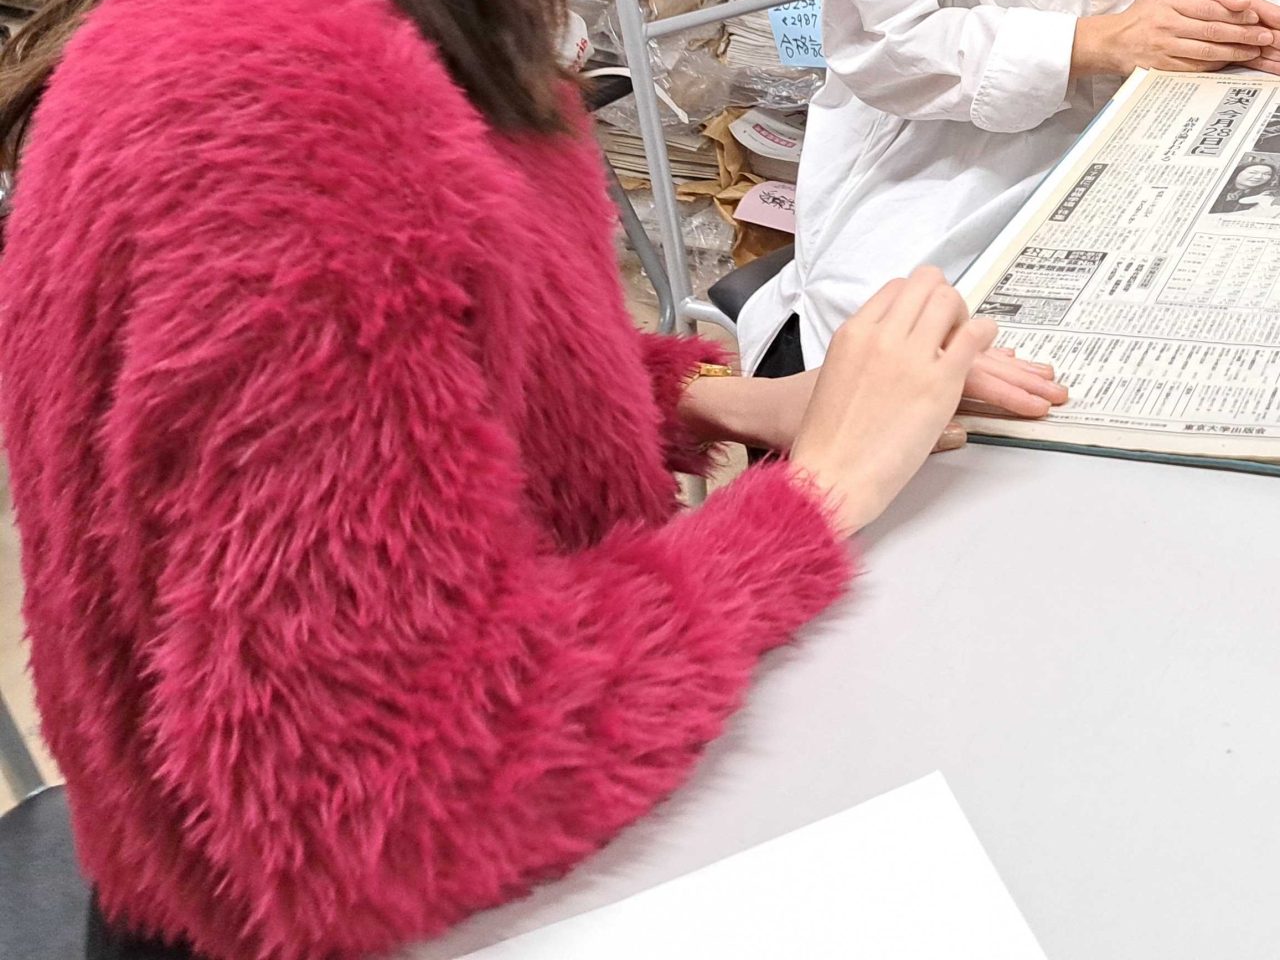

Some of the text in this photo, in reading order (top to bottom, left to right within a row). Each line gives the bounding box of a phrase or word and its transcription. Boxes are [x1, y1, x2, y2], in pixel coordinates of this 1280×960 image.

[1182, 423, 1267, 435] 東京大学出版会
